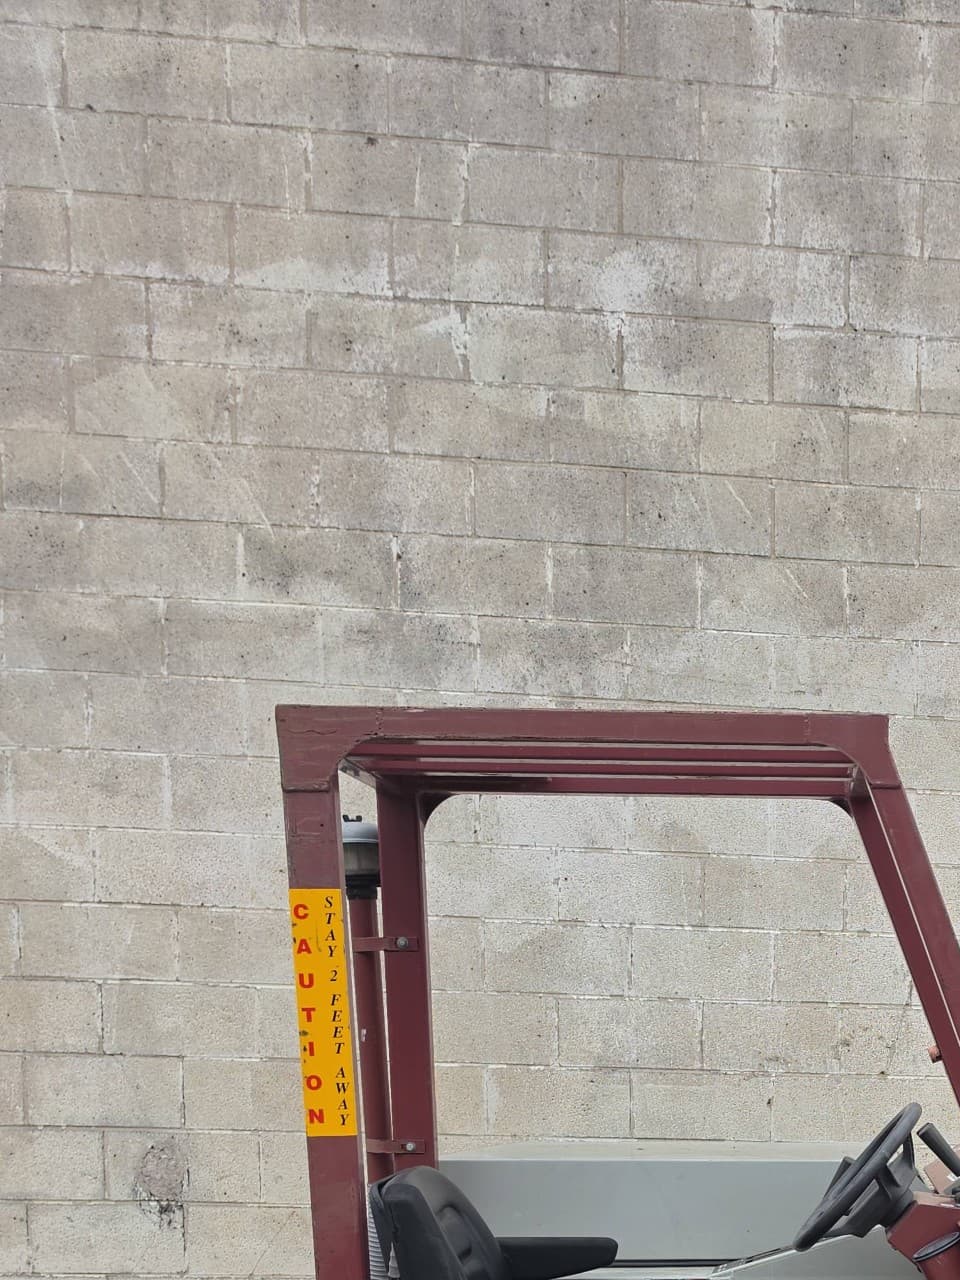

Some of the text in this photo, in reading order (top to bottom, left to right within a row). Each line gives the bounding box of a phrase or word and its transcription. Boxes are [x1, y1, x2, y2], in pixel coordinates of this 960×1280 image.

[293, 903, 325, 1124] CAUTION
[324, 895, 350, 1126] STAY 2 FEET AWAY
